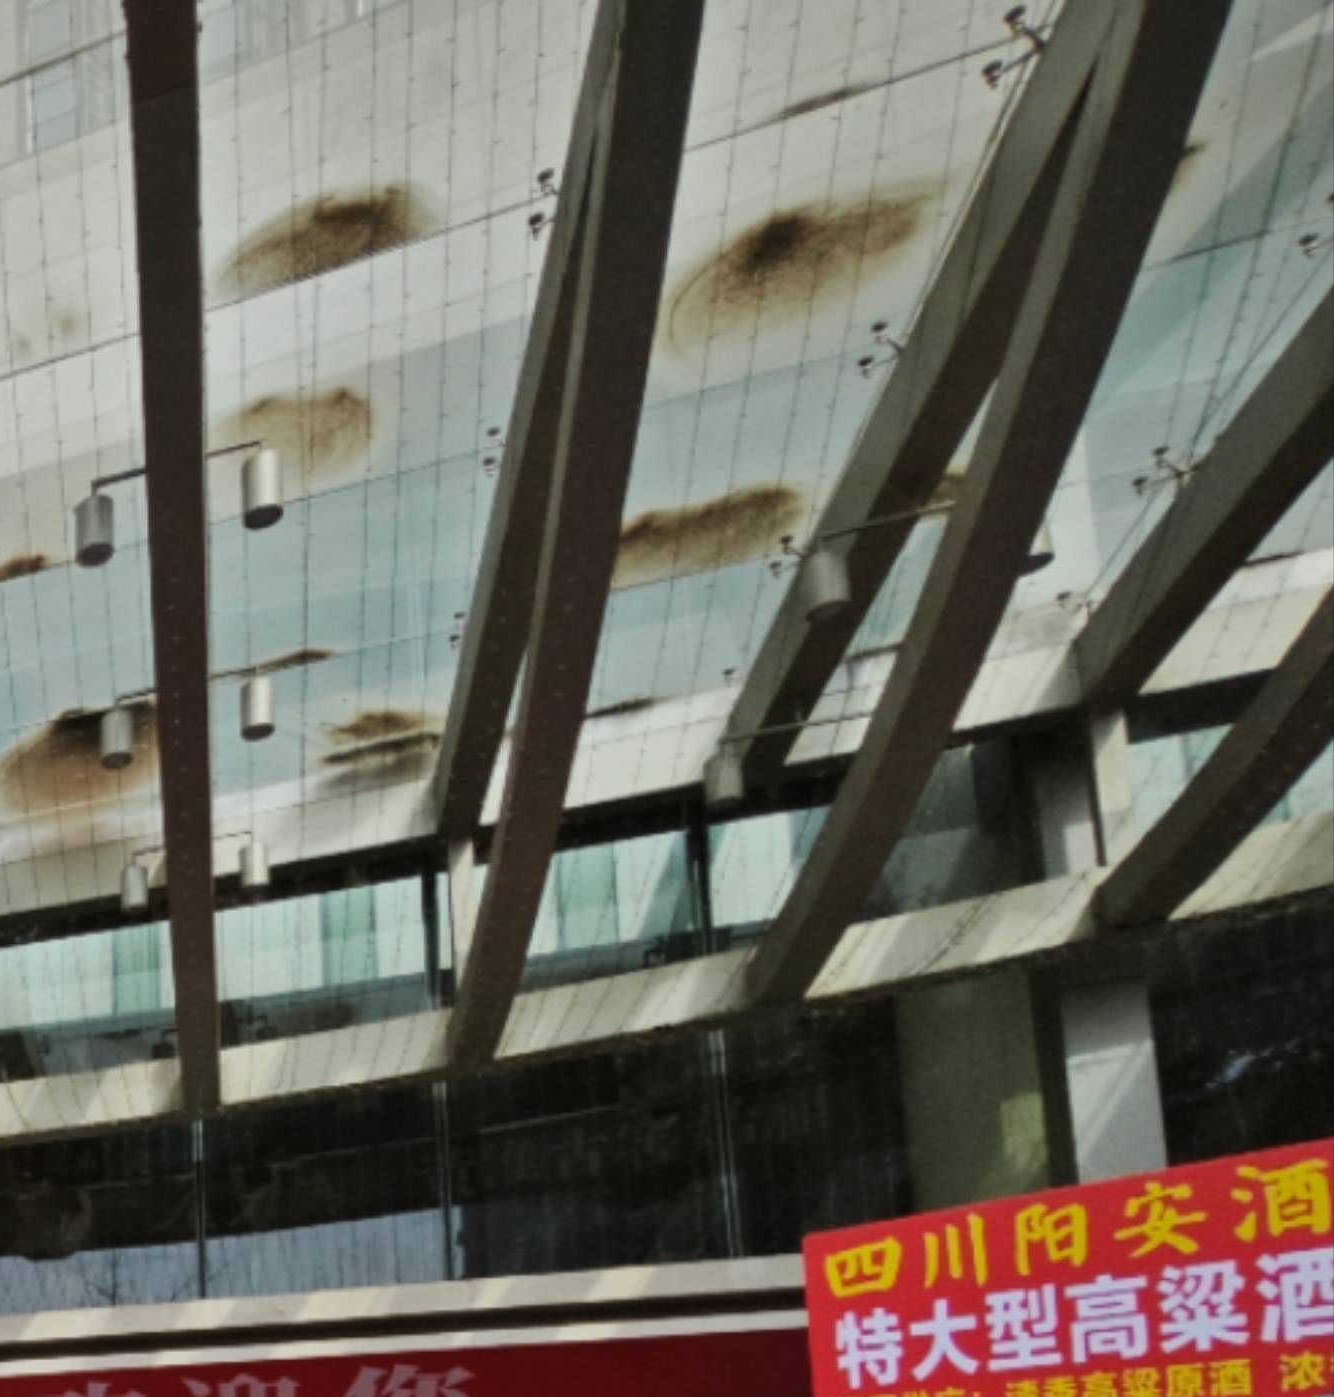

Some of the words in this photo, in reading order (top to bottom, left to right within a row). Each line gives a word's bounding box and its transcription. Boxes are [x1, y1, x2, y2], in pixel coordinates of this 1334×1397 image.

[823, 1158, 1331, 1298] 四川阳安酒
[1280, 1352, 1334, 1391] 浓
